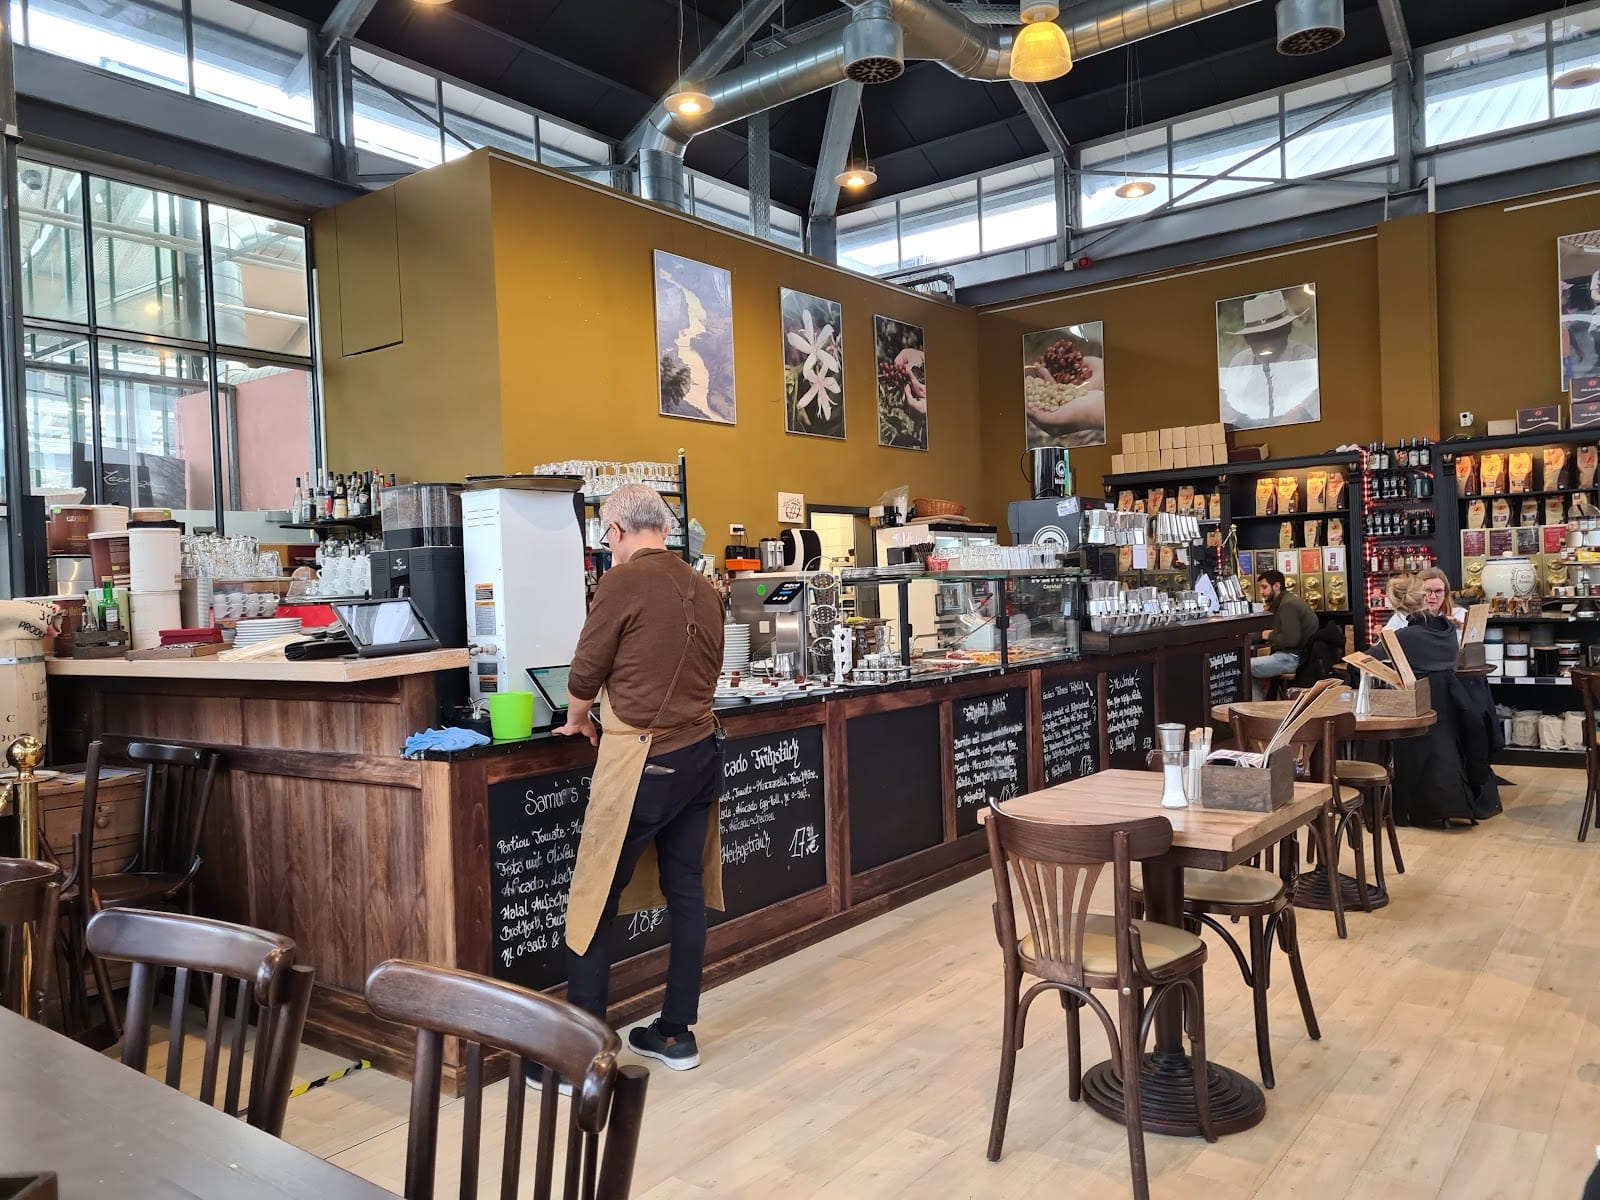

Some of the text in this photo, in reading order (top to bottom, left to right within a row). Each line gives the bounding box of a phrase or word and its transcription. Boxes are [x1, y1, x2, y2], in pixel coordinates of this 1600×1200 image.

[724, 737, 800, 778] cado Frühstück
[496, 858, 525, 877] Feta
[526, 851, 543, 870] mit
[551, 865, 575, 886] Lach
[500, 898, 530, 920] Halal
[551, 931, 561, 949] &
